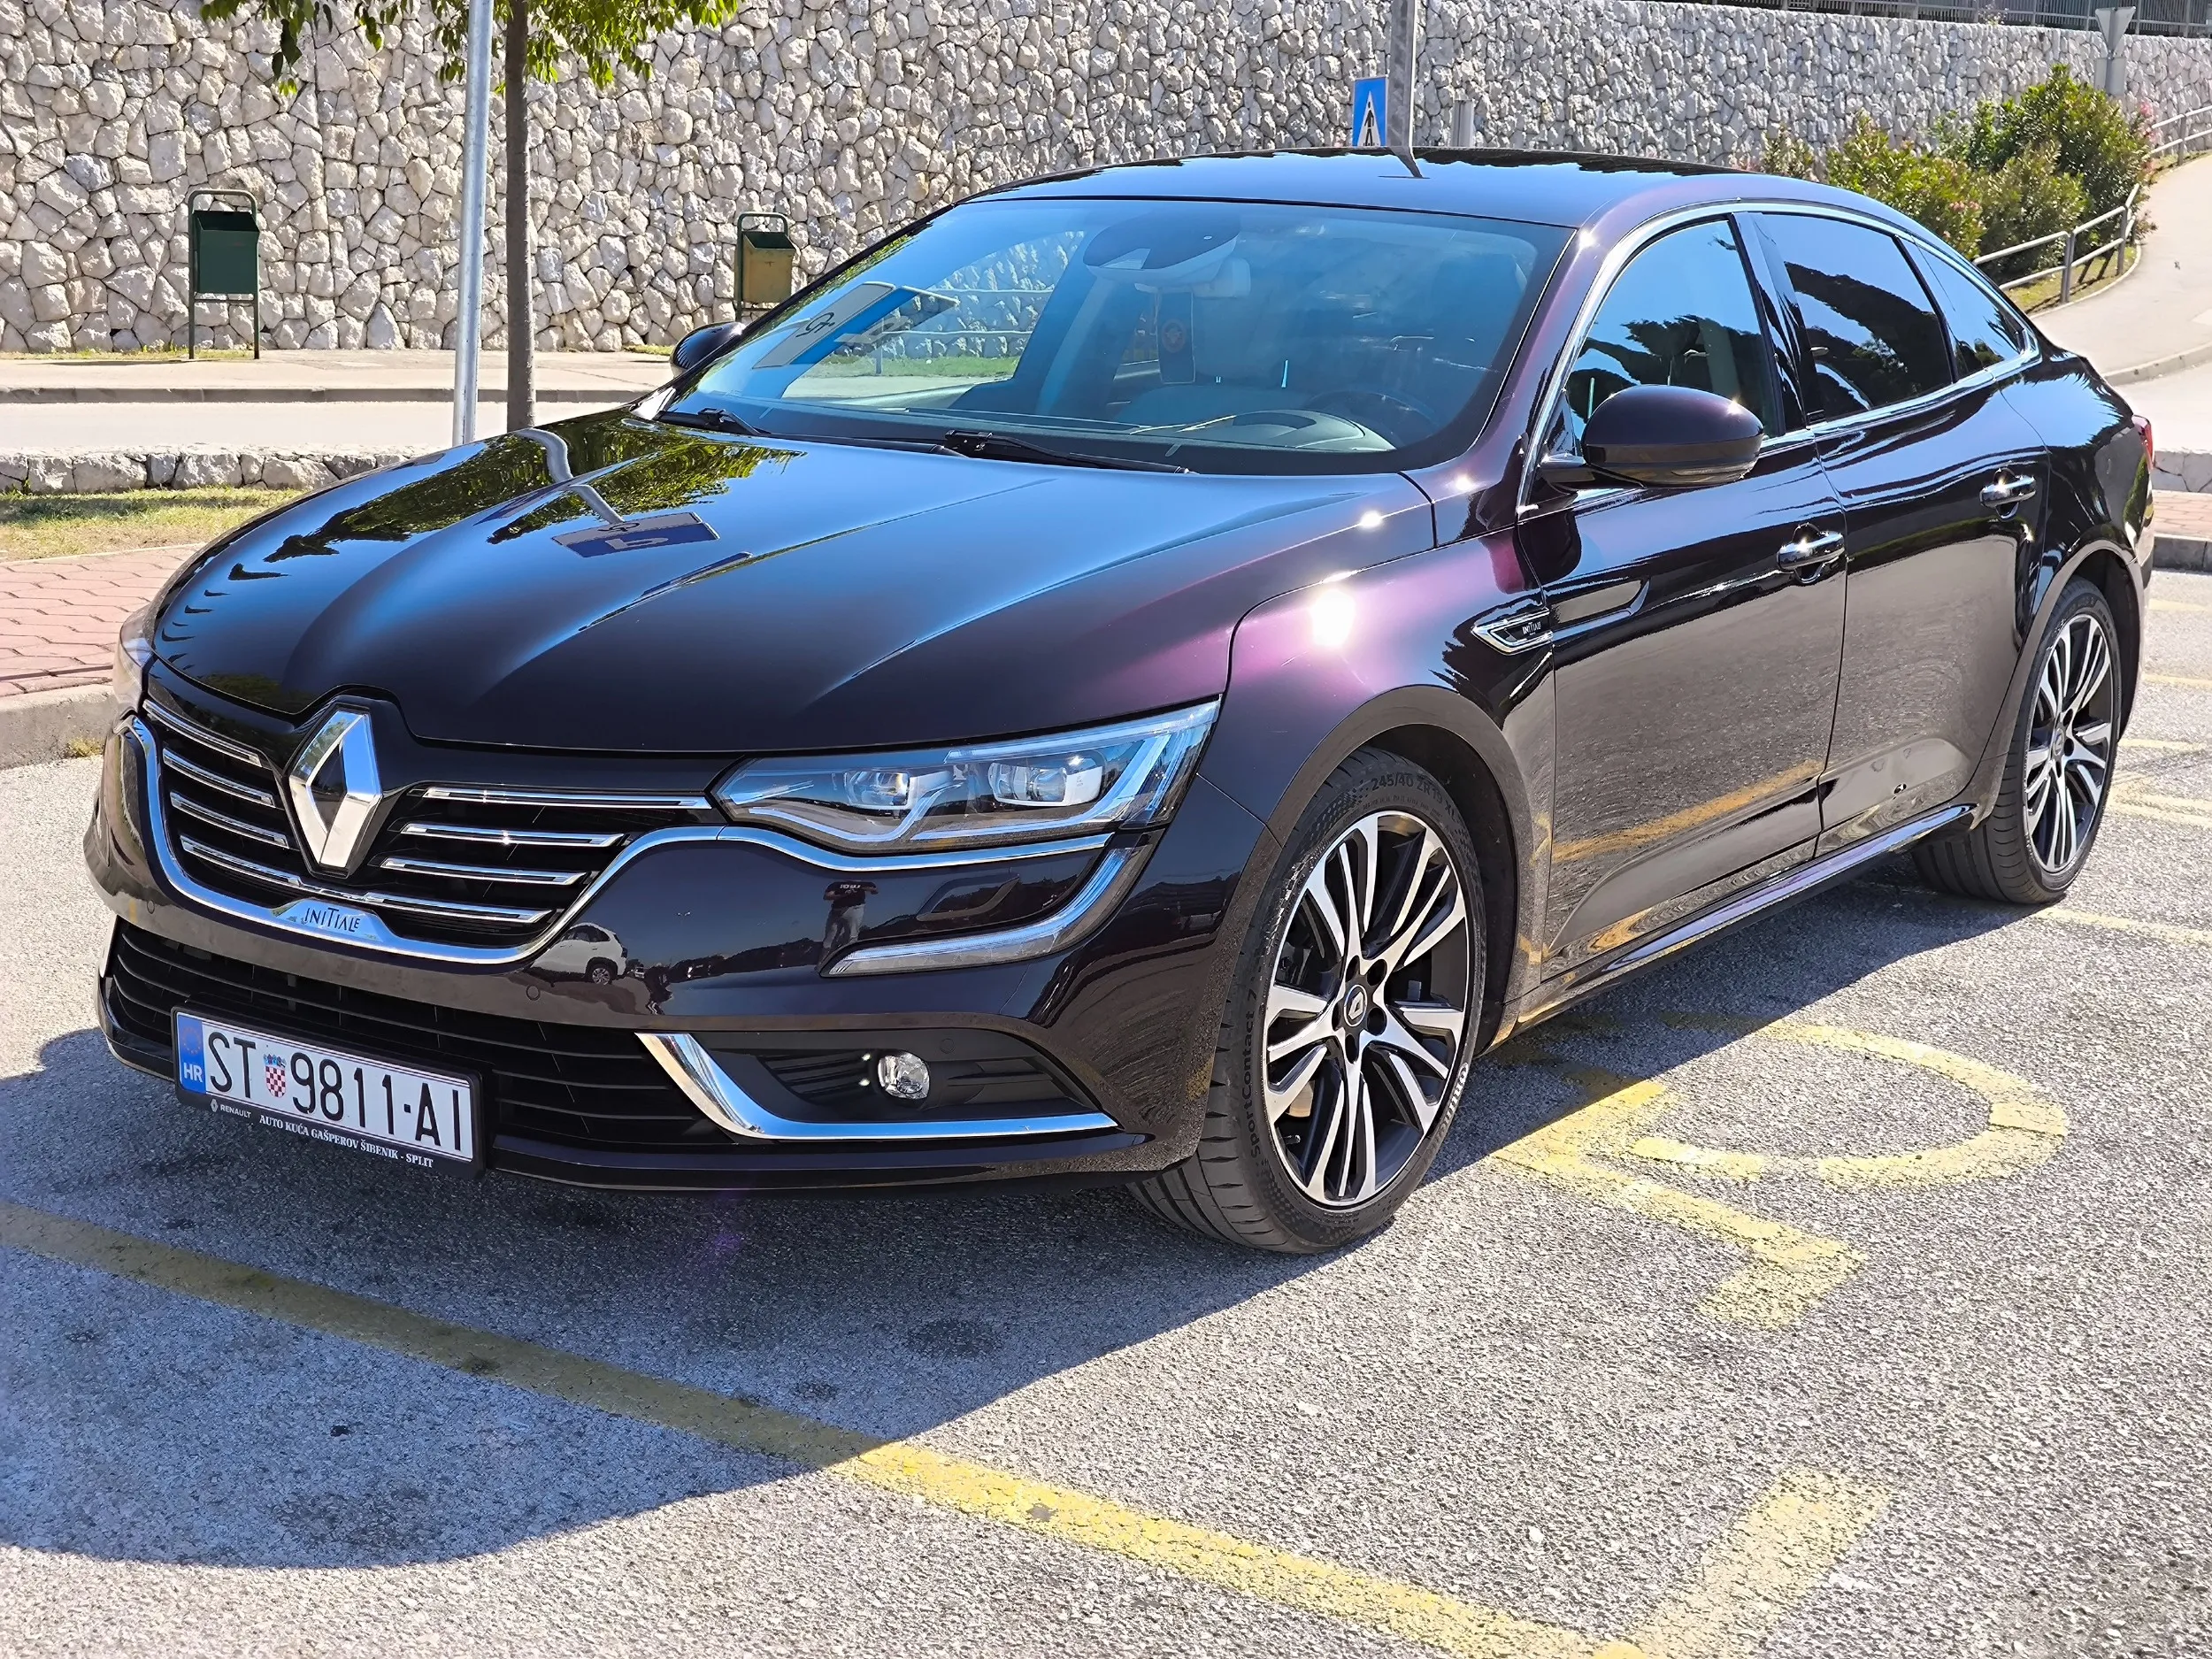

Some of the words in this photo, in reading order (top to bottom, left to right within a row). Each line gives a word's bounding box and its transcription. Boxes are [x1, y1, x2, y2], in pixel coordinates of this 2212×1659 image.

[304, 907, 361, 933] INITIALE
[182, 1063, 203, 1084] HR
[208, 1031, 257, 1100] ST
[1241, 1010, 1261, 1159] SportContact
[219, 1103, 252, 1118] RENAULT
[259, 1114, 284, 1129] AUTO
[285, 1123, 310, 1137] KUĆA
[311, 1128, 359, 1149] GAŠPEROV
[360, 1138, 399, 1160] ŠIBENIK
[405, 1153, 434, 1168] SPLIT
